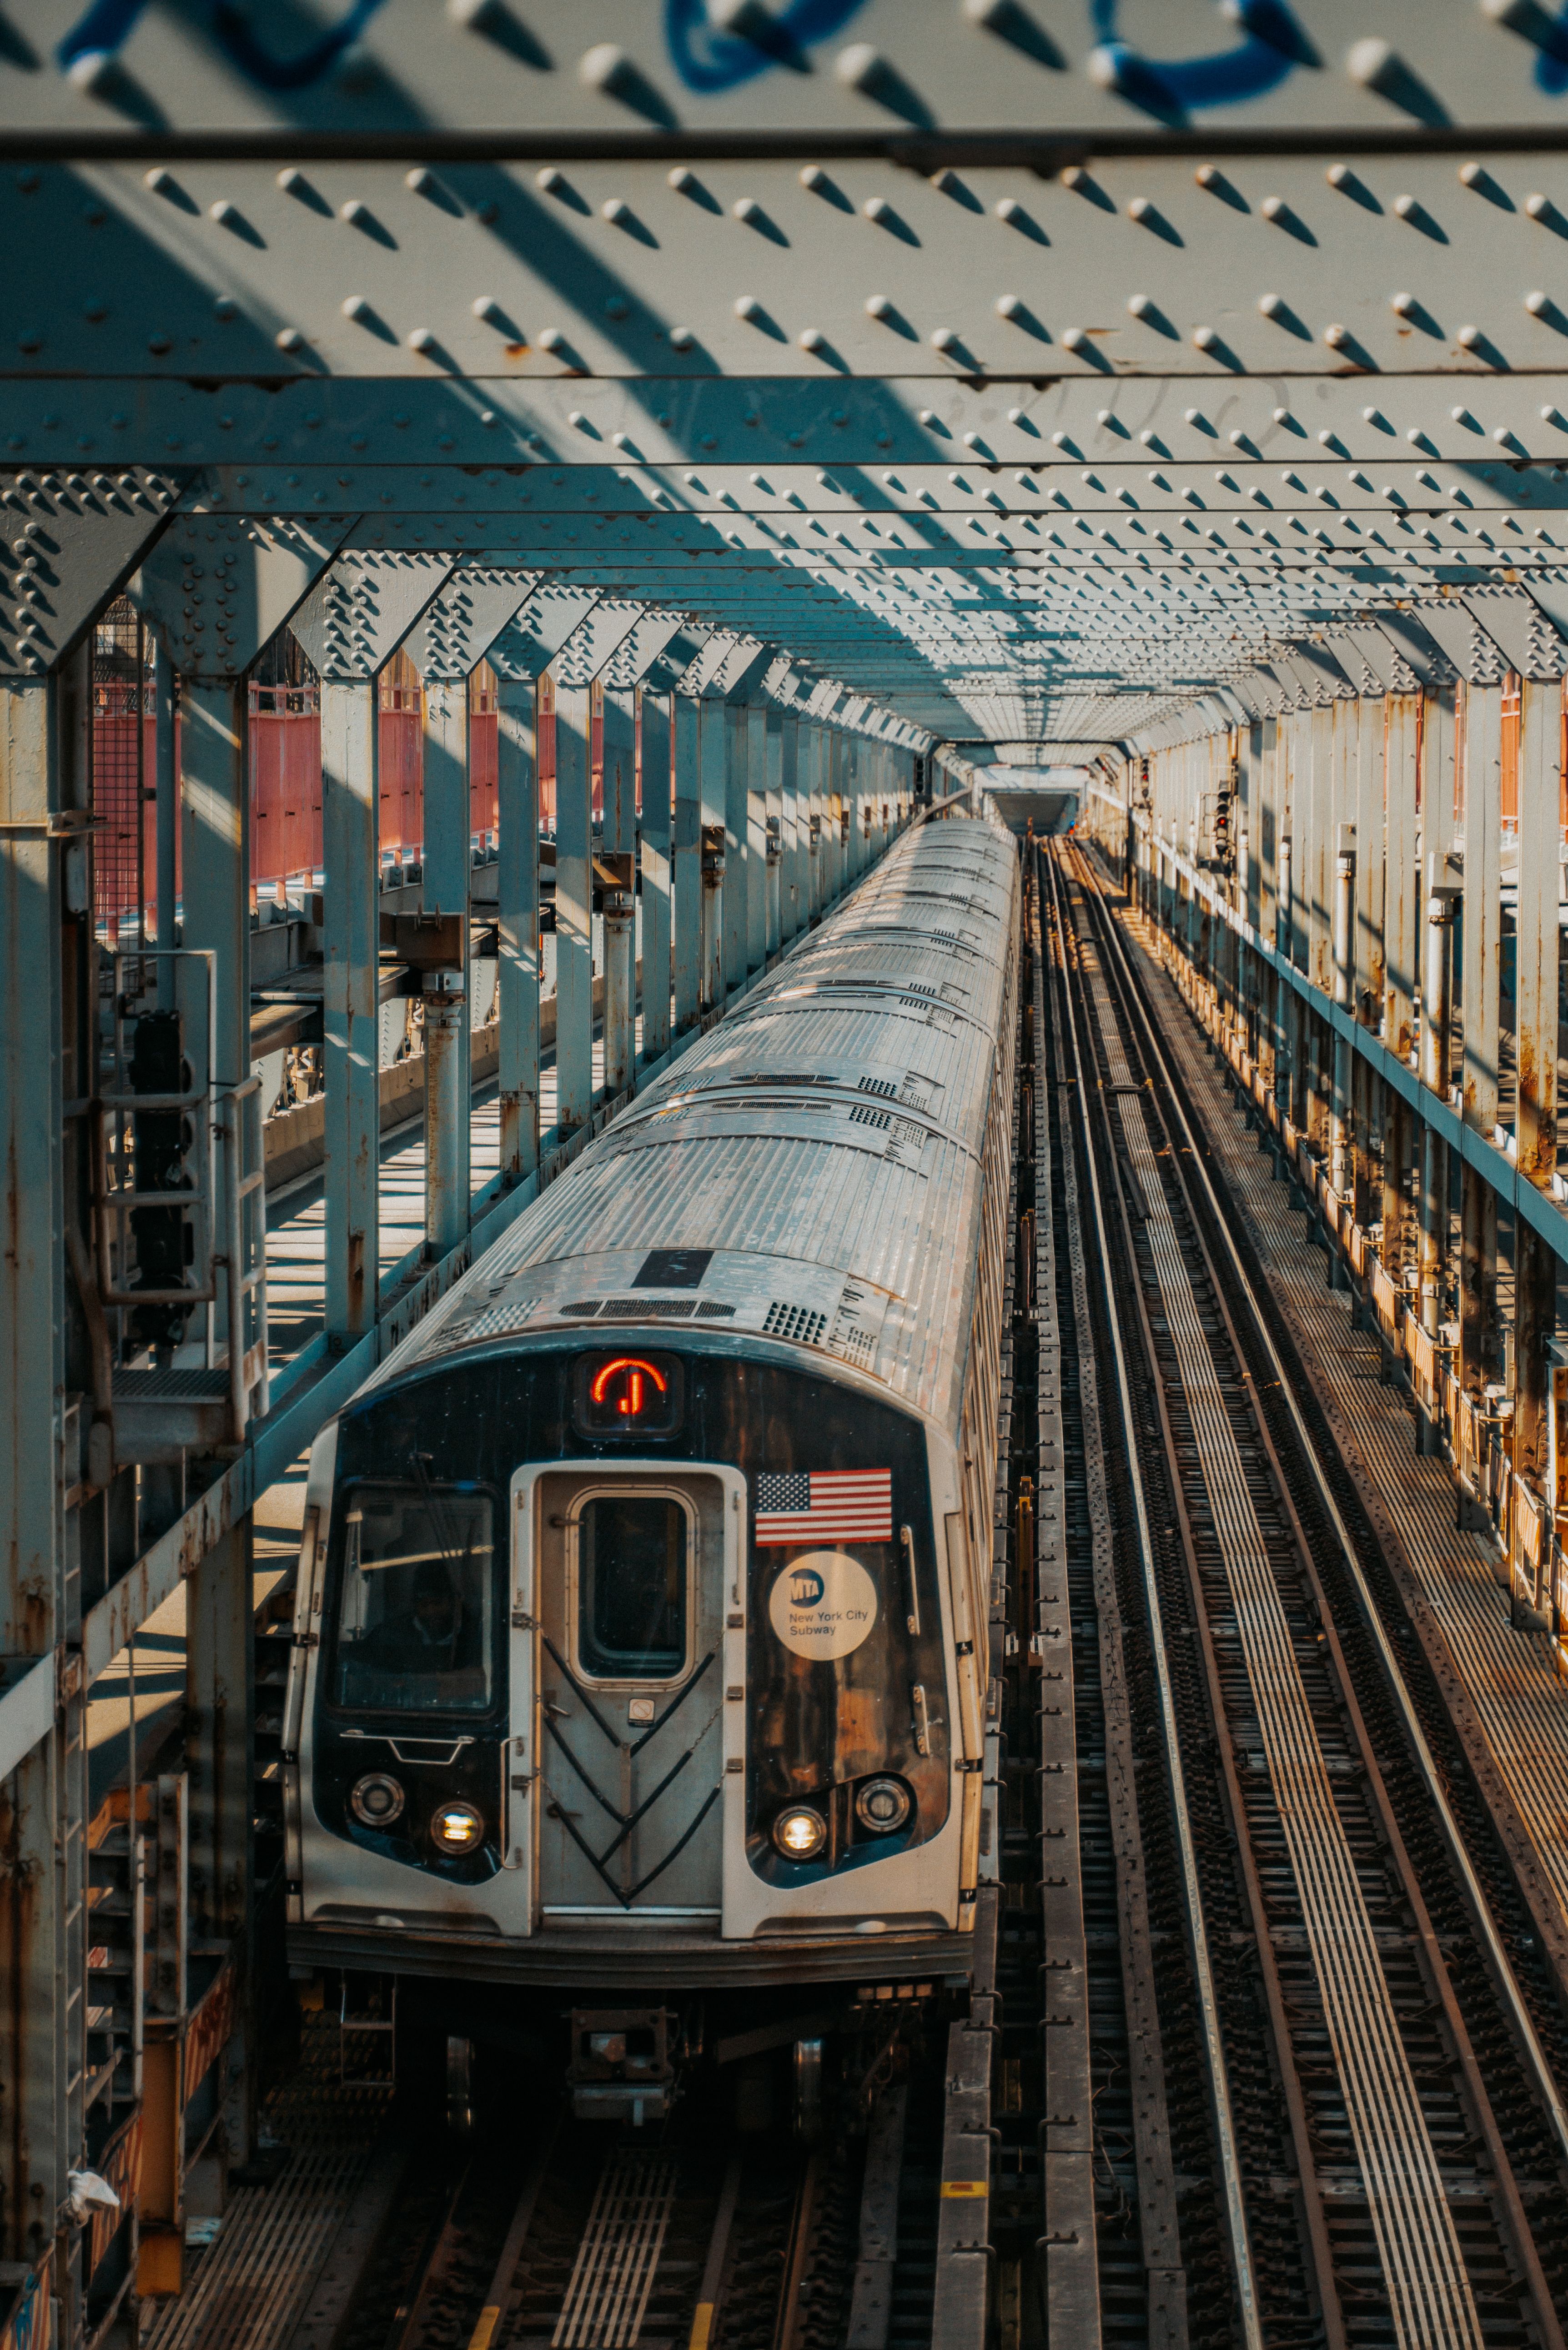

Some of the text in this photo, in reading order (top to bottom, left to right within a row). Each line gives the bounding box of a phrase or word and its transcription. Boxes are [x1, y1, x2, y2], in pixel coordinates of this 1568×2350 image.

[789, 1576, 819, 1602] MTA
[789, 1610, 868, 1623] New York City
[790, 1626, 836, 1636] Subway
